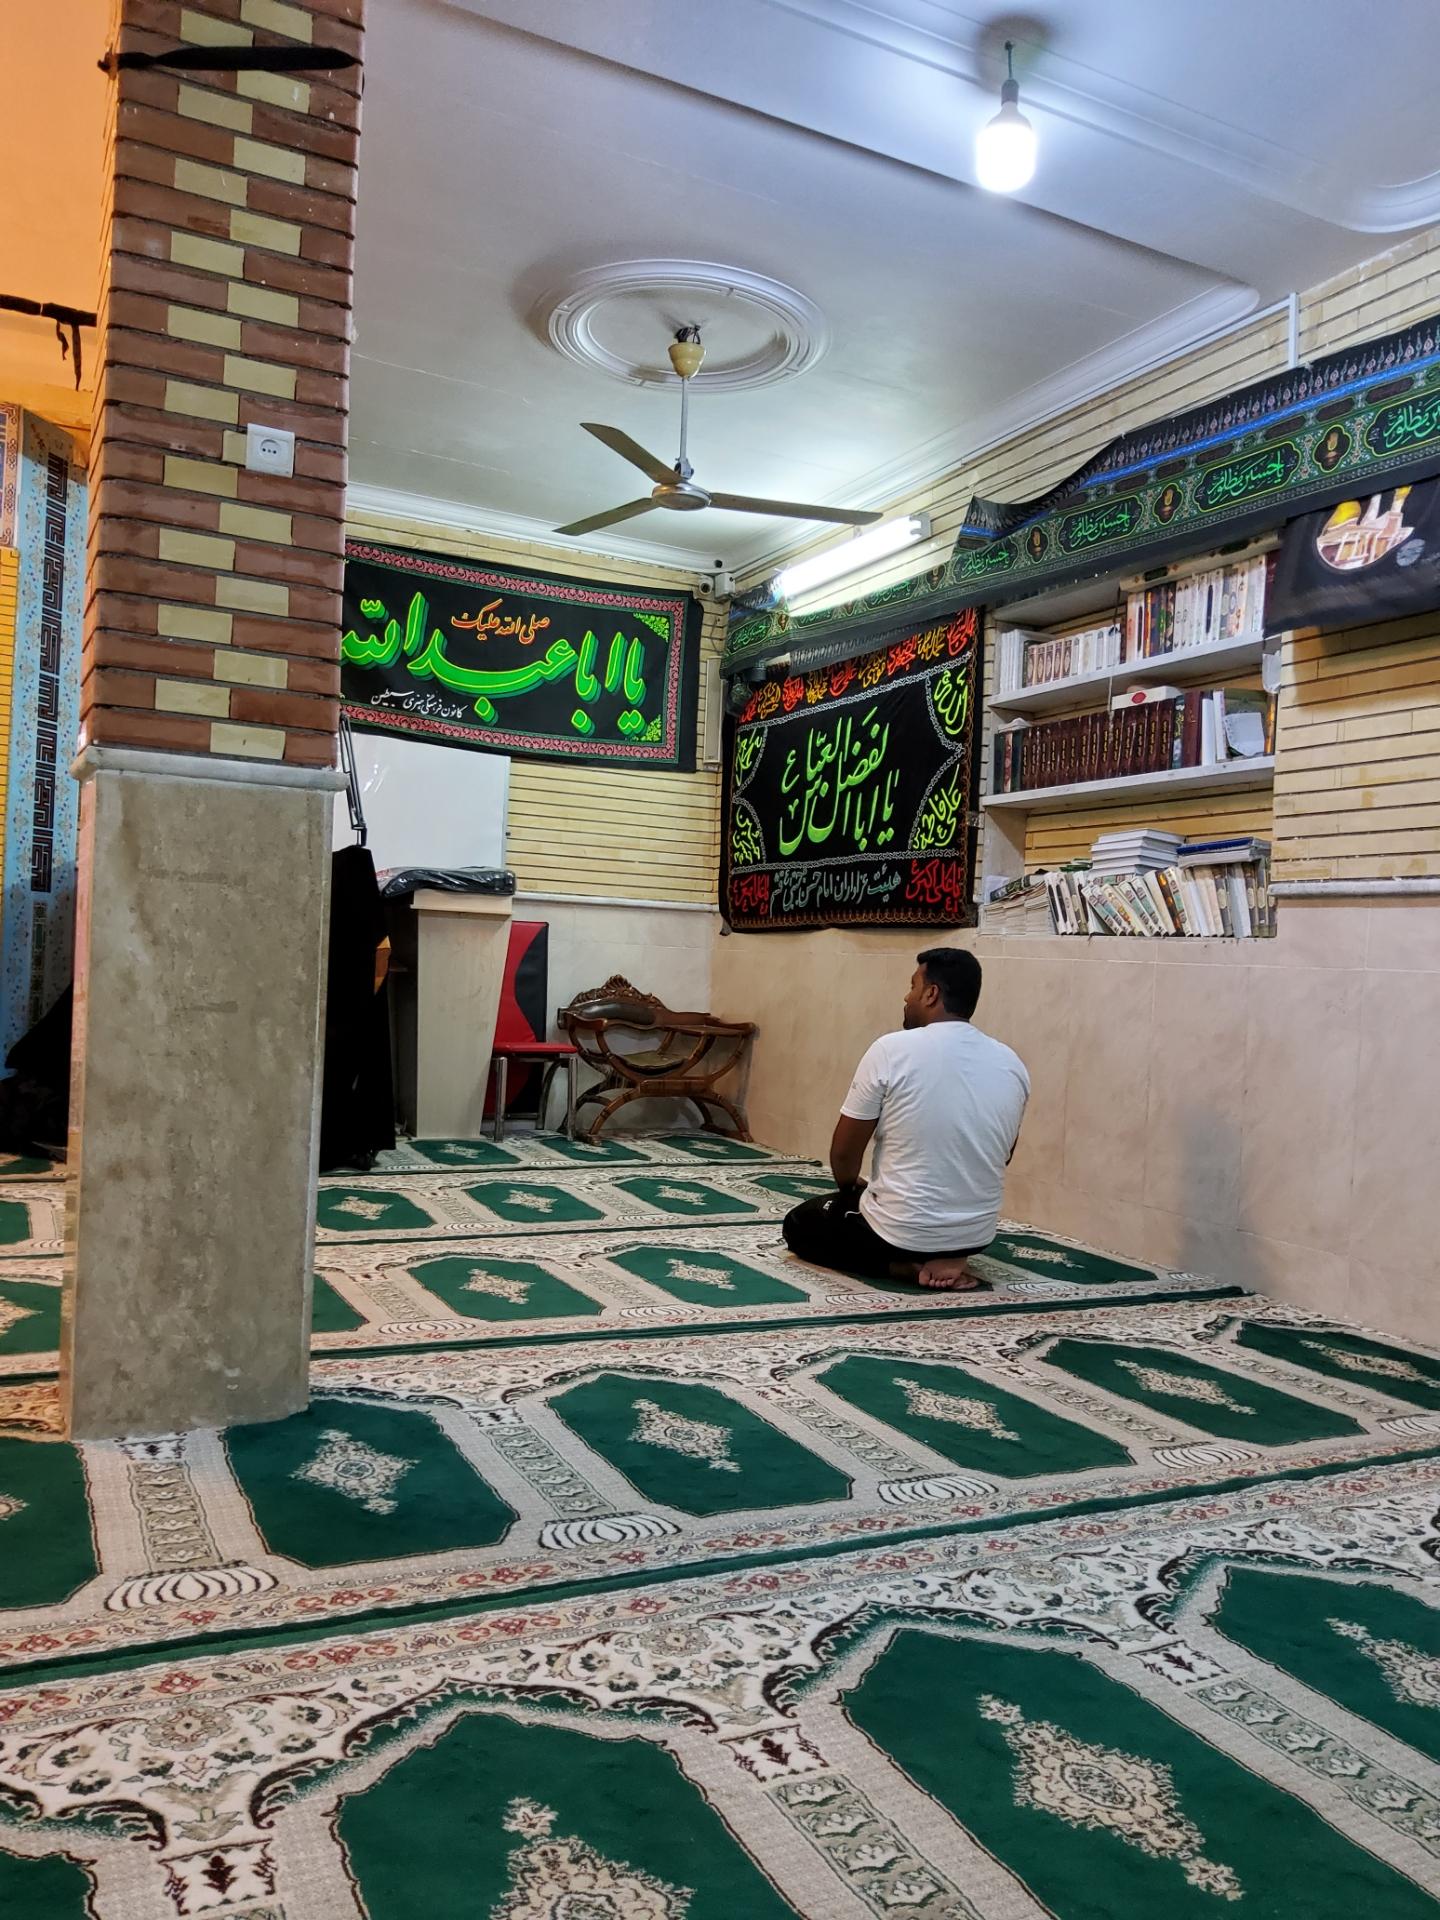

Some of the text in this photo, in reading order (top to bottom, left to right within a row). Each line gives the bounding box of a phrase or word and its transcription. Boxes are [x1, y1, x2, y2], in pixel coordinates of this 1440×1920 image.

[451, 598, 551, 645] صلی الله علیک
[370, 688, 469, 718] کانون فرهنگی هنری سبطین
[617, 636, 647, 736] یا
